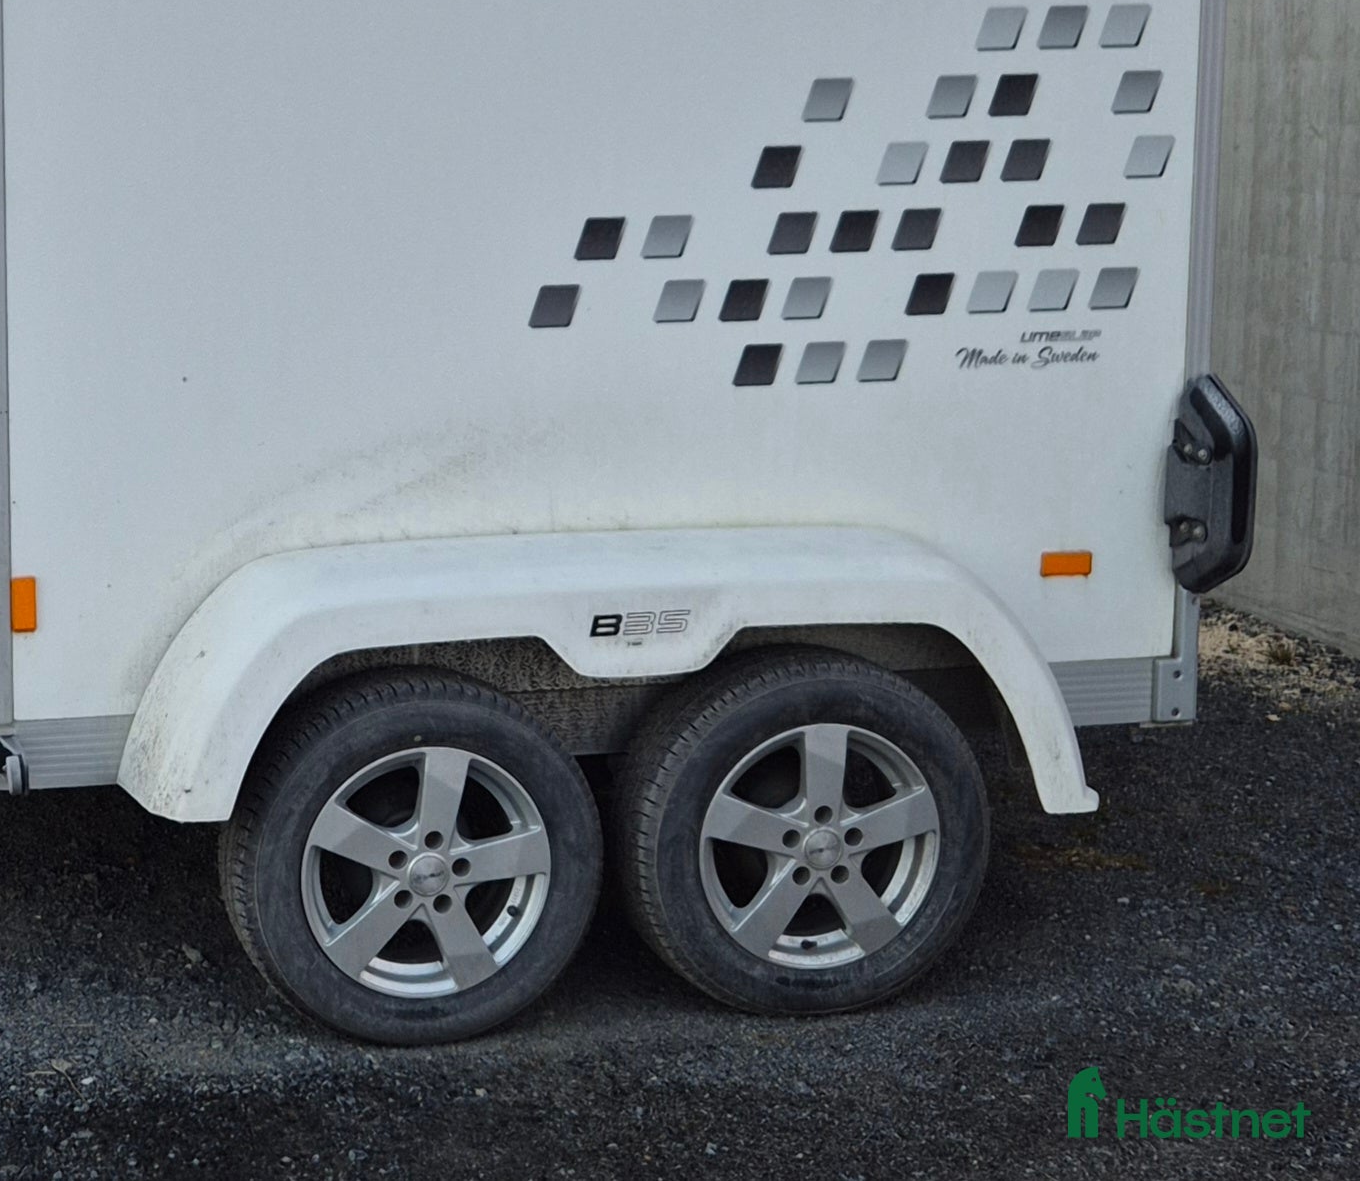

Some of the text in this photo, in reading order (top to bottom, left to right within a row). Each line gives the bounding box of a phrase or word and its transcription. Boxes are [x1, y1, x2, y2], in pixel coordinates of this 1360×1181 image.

[955, 345, 1100, 369] Made in Sweden
[589, 609, 691, 637] B35
